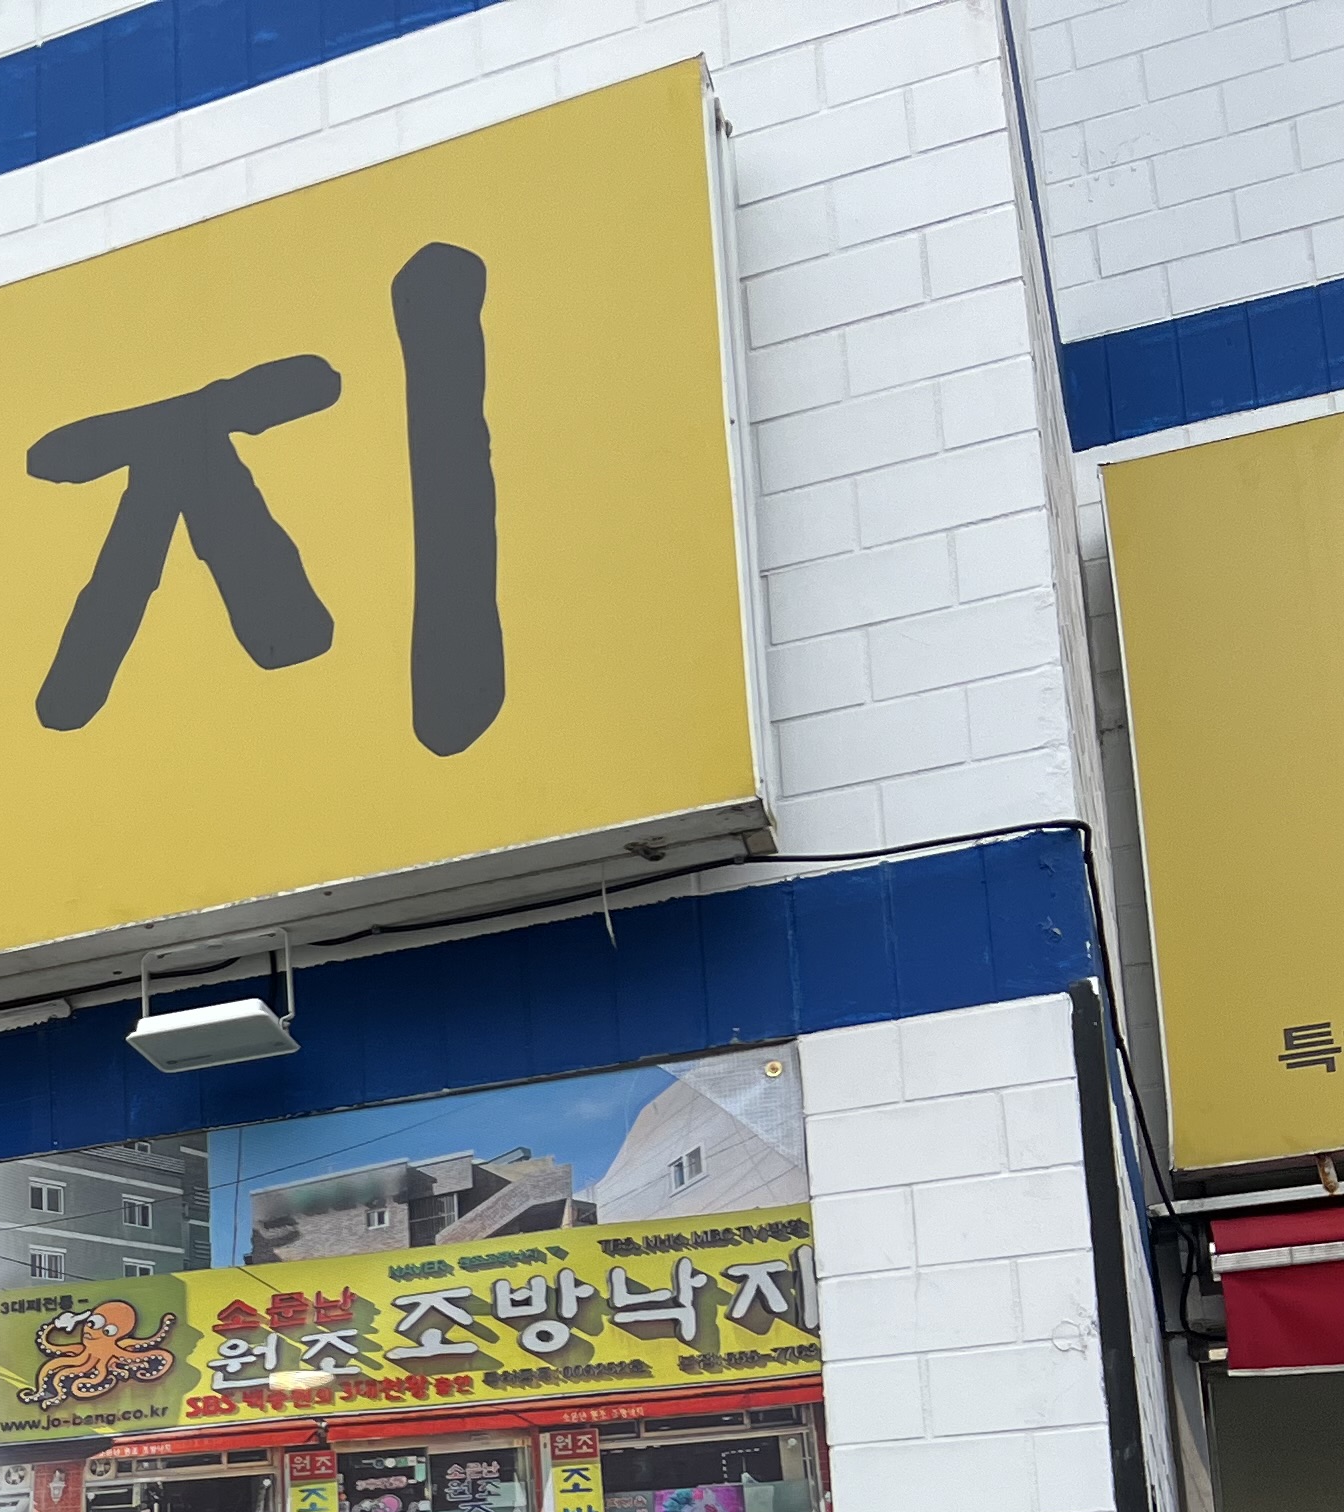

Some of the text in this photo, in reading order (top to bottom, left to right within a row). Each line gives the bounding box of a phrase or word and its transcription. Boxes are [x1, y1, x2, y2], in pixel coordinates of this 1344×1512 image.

[208, 1244, 818, 1391] 원조 조방낙지
[213, 1284, 356, 1332] 소문난
[0, 1403, 170, 1433] www.jo-bang.co.kr
[553, 1433, 595, 1455] 원조
[291, 1455, 334, 1477] 원조
